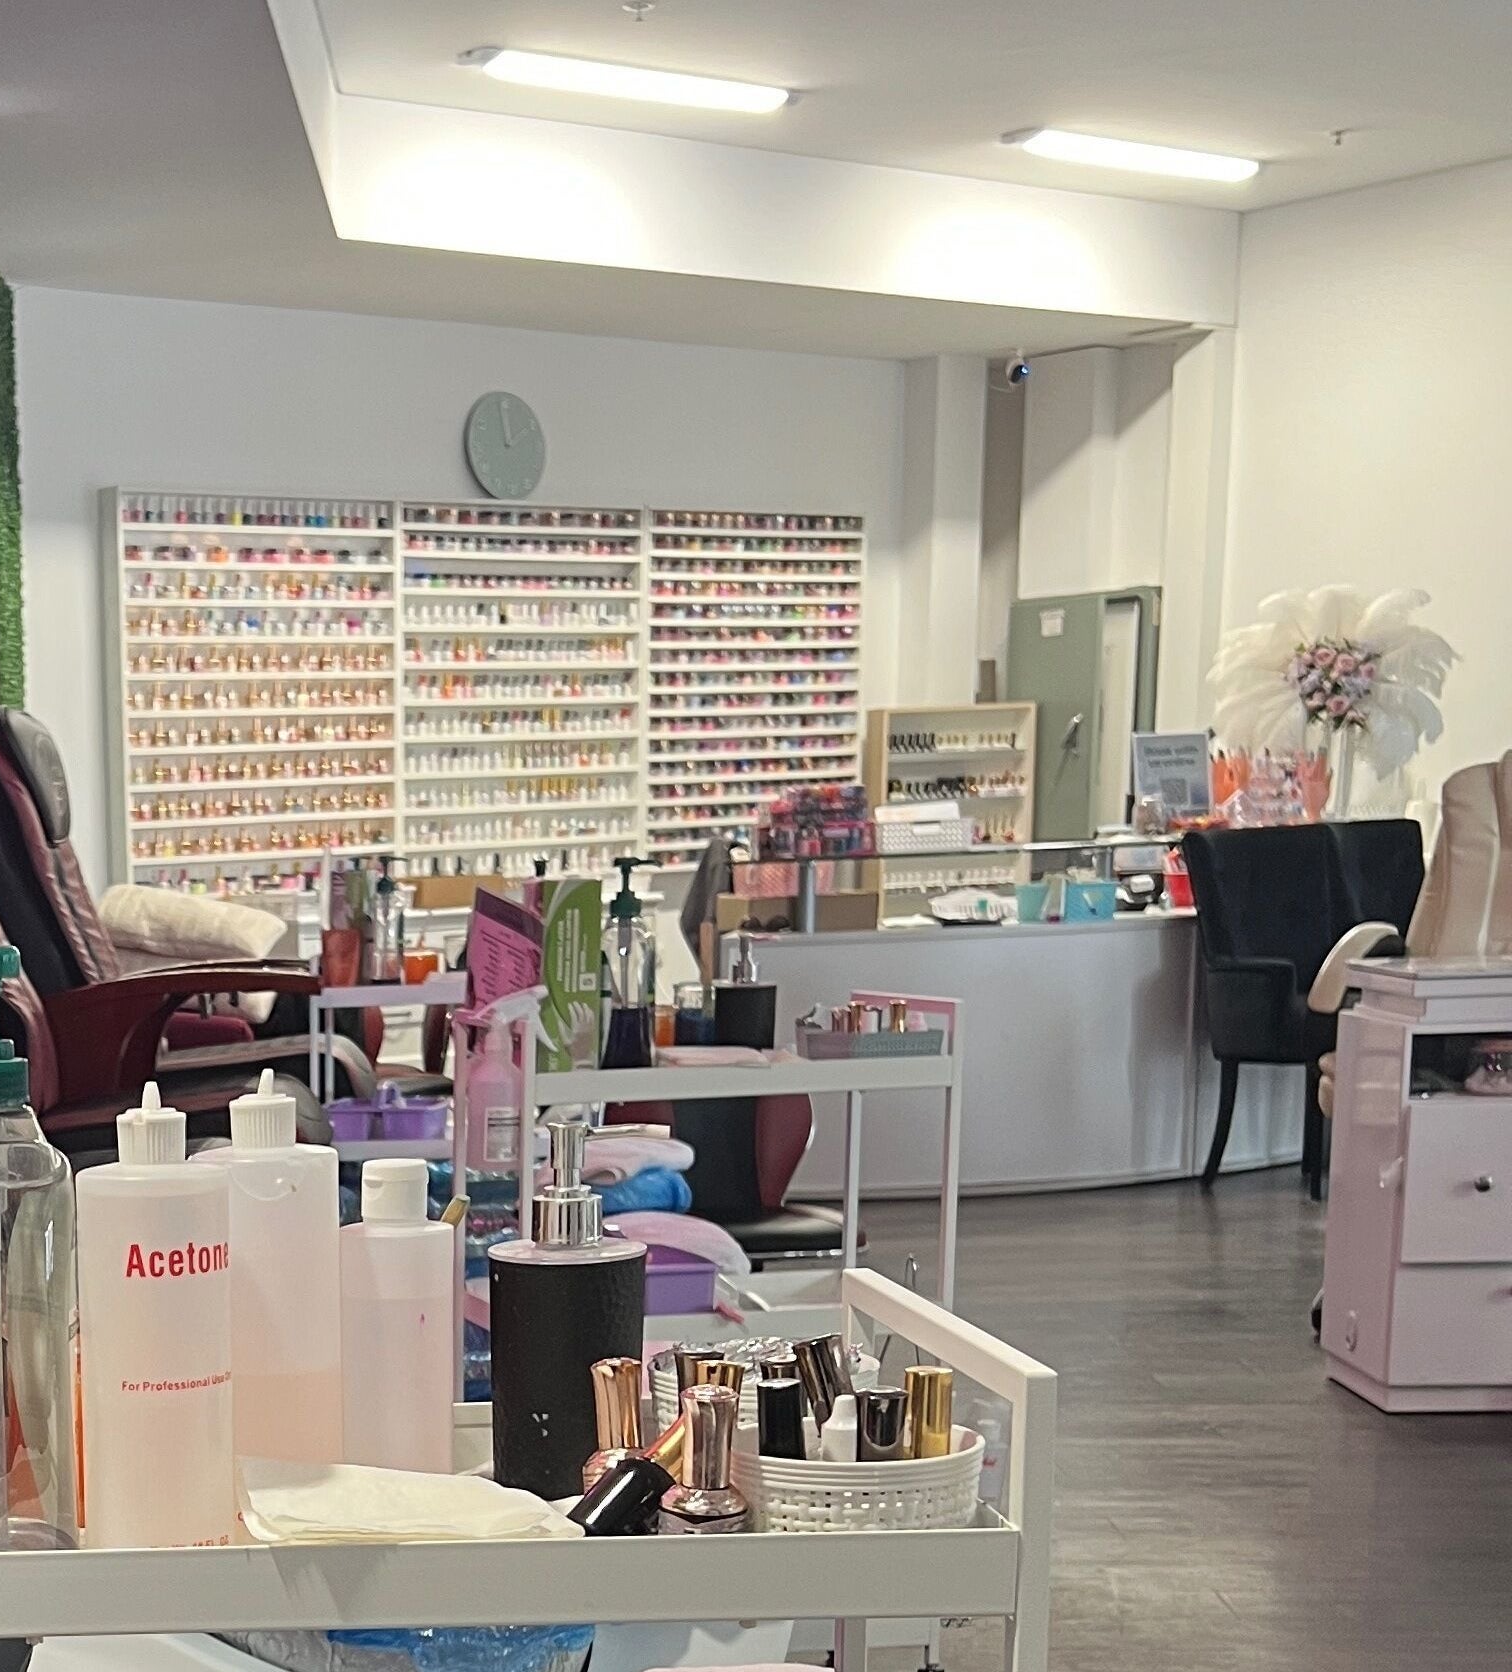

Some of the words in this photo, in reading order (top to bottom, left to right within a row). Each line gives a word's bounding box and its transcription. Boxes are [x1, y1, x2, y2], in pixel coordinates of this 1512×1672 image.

[126, 1241, 229, 1278] Acetone
[121, 1380, 139, 1392] For
[142, 1375, 210, 1392] Professional
